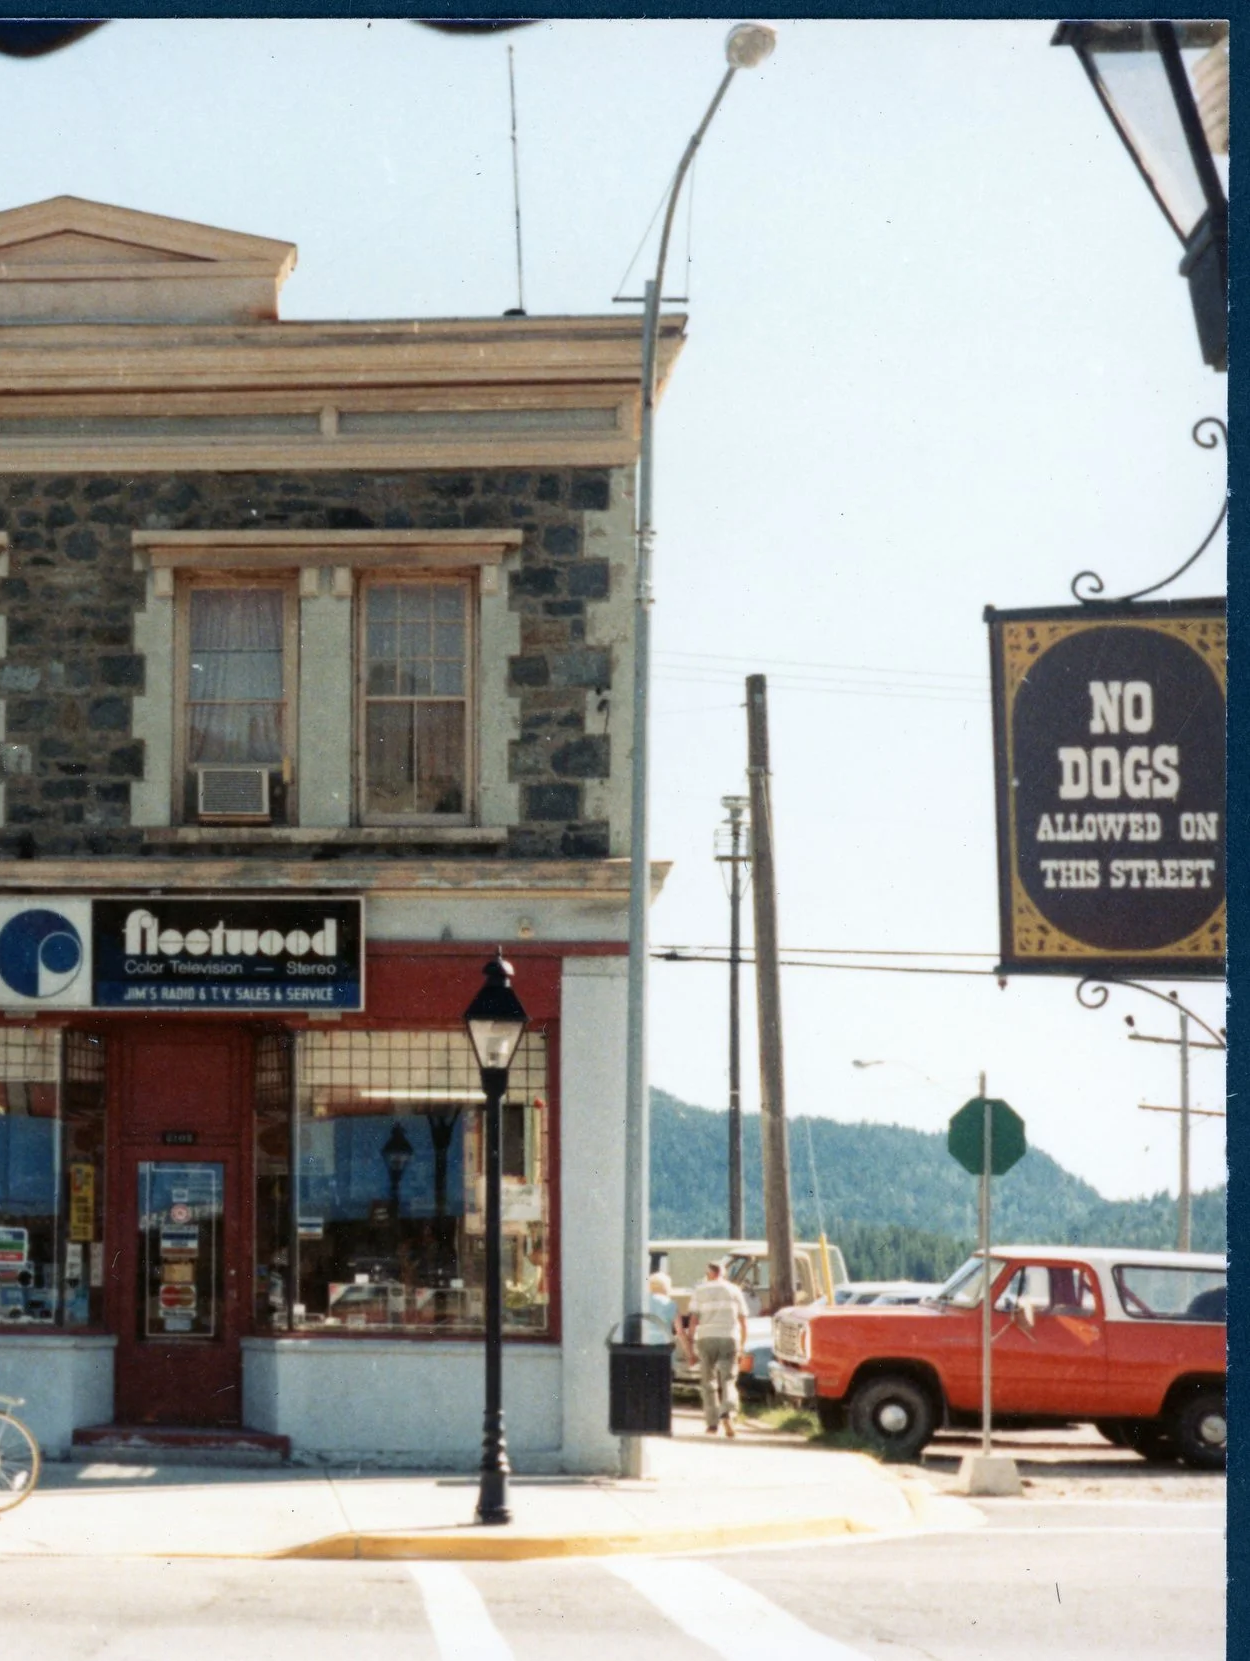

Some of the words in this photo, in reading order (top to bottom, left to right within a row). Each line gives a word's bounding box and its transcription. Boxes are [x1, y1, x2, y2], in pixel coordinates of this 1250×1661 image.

[1088, 680, 1153, 734] NO
[1057, 745, 1180, 801] DOGS
[1036, 812, 1162, 842] ALLOWED
[1179, 812, 1219, 842] ON
[1040, 859, 1101, 889] THIS
[1109, 859, 1216, 889] STREET
[124, 960, 165, 975] Color
[169, 960, 244, 975] Television
[286, 961, 337, 976] Stereo
[161, 986, 195, 1001] RADIO
[235, 986, 271, 1001] SALES
[286, 986, 335, 1001] SERVICE
